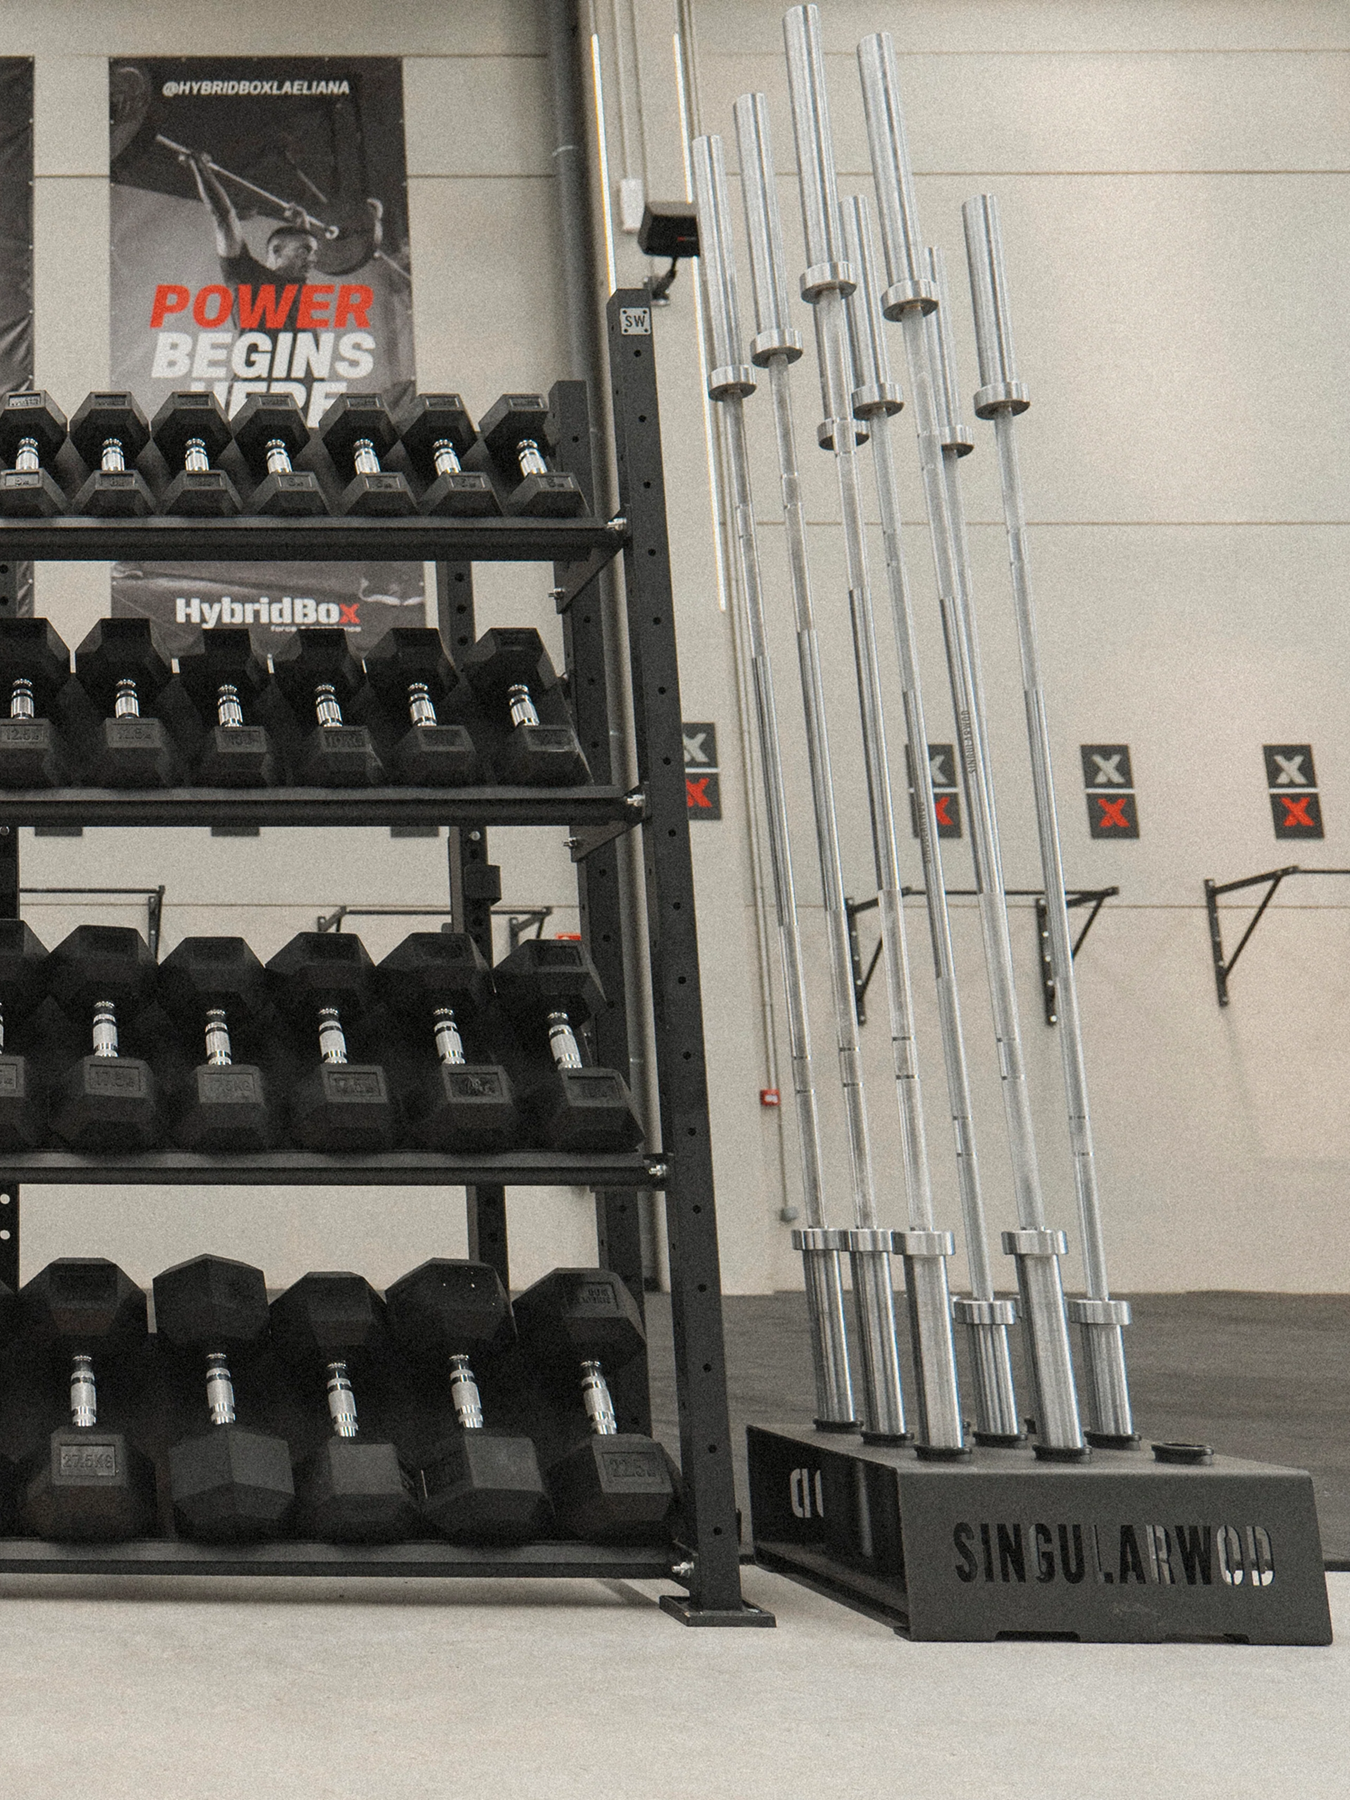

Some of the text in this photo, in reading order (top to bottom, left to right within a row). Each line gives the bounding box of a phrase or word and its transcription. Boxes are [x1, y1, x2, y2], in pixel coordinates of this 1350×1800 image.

[162, 80, 350, 97] @HYBRIDBOXLAELIANA
[150, 284, 374, 329] POWER
[625, 315, 646, 328] SW
[151, 332, 376, 379] BEGINS
[175, 597, 360, 629] HybridBox
[61, 1452, 113, 1470] 27.5KG
[952, 1522, 1276, 1587] SINGULARWOD
